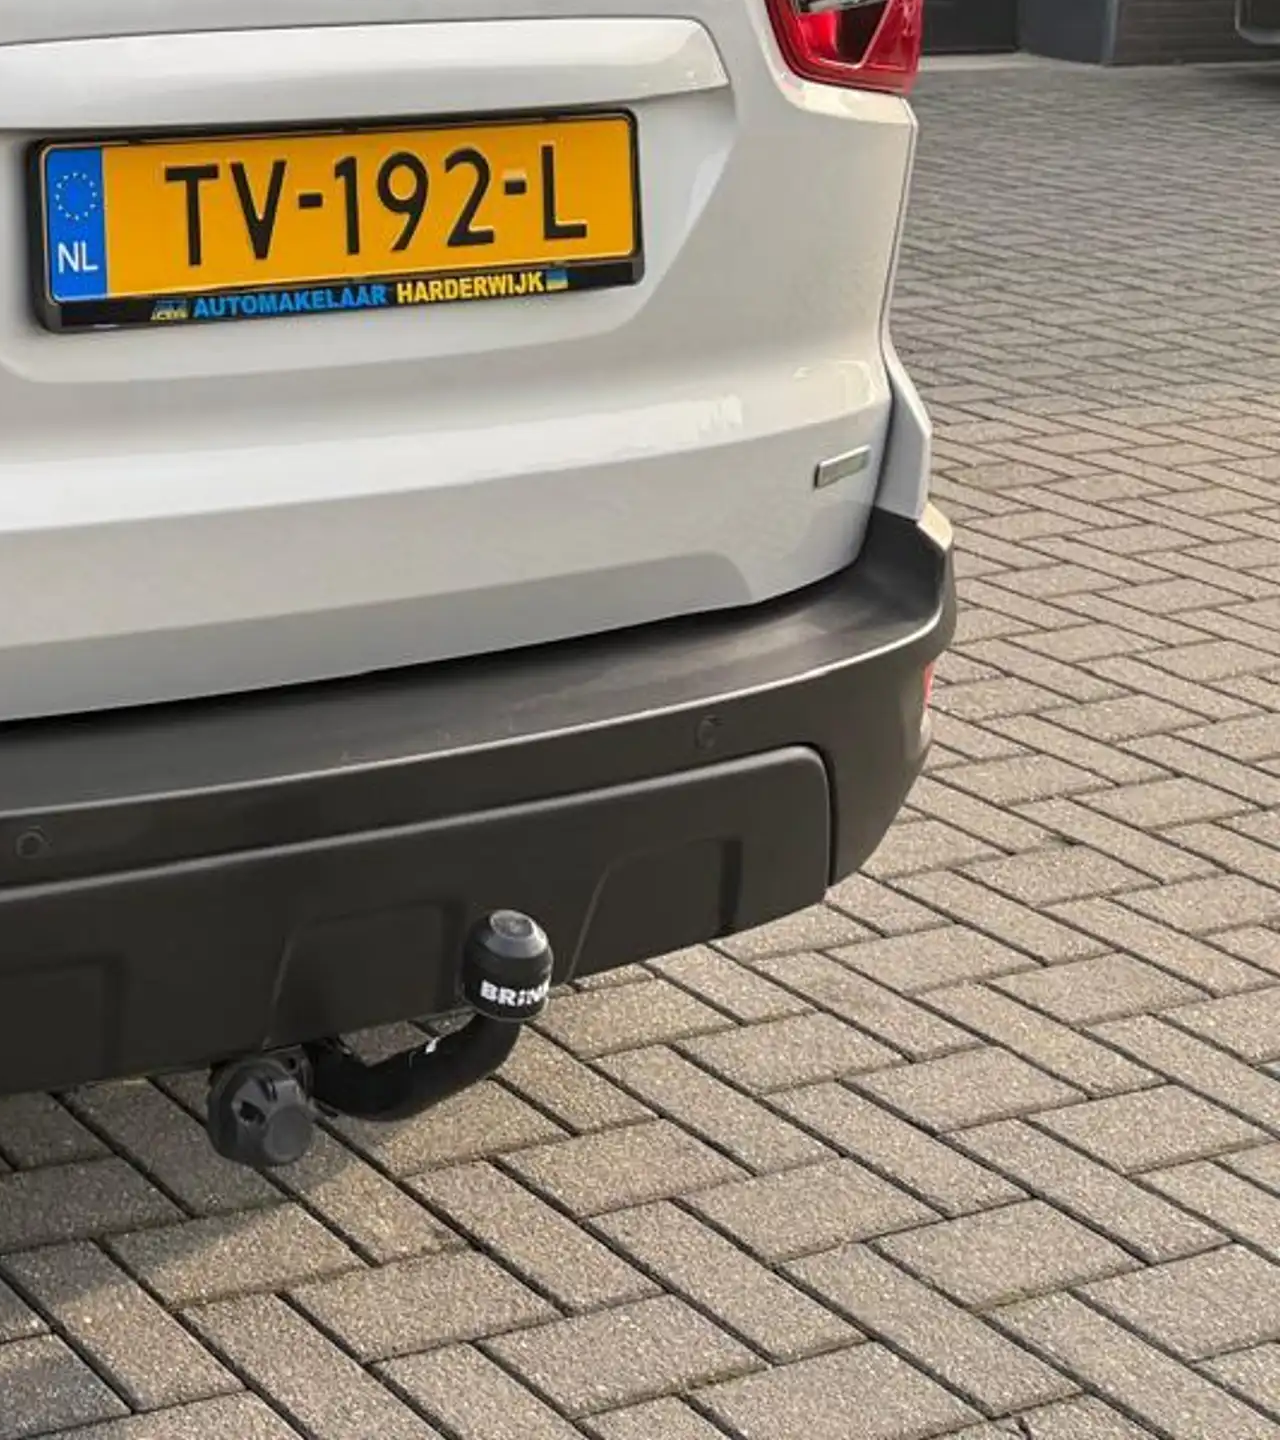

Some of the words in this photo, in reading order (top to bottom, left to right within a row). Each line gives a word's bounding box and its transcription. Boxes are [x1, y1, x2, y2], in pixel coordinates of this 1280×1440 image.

[163, 144, 587, 267] TV-192-L
[56, 242, 99, 275] NL
[192, 283, 388, 319] AUTOMAKELAAR
[396, 270, 545, 305] HARDERWIJK
